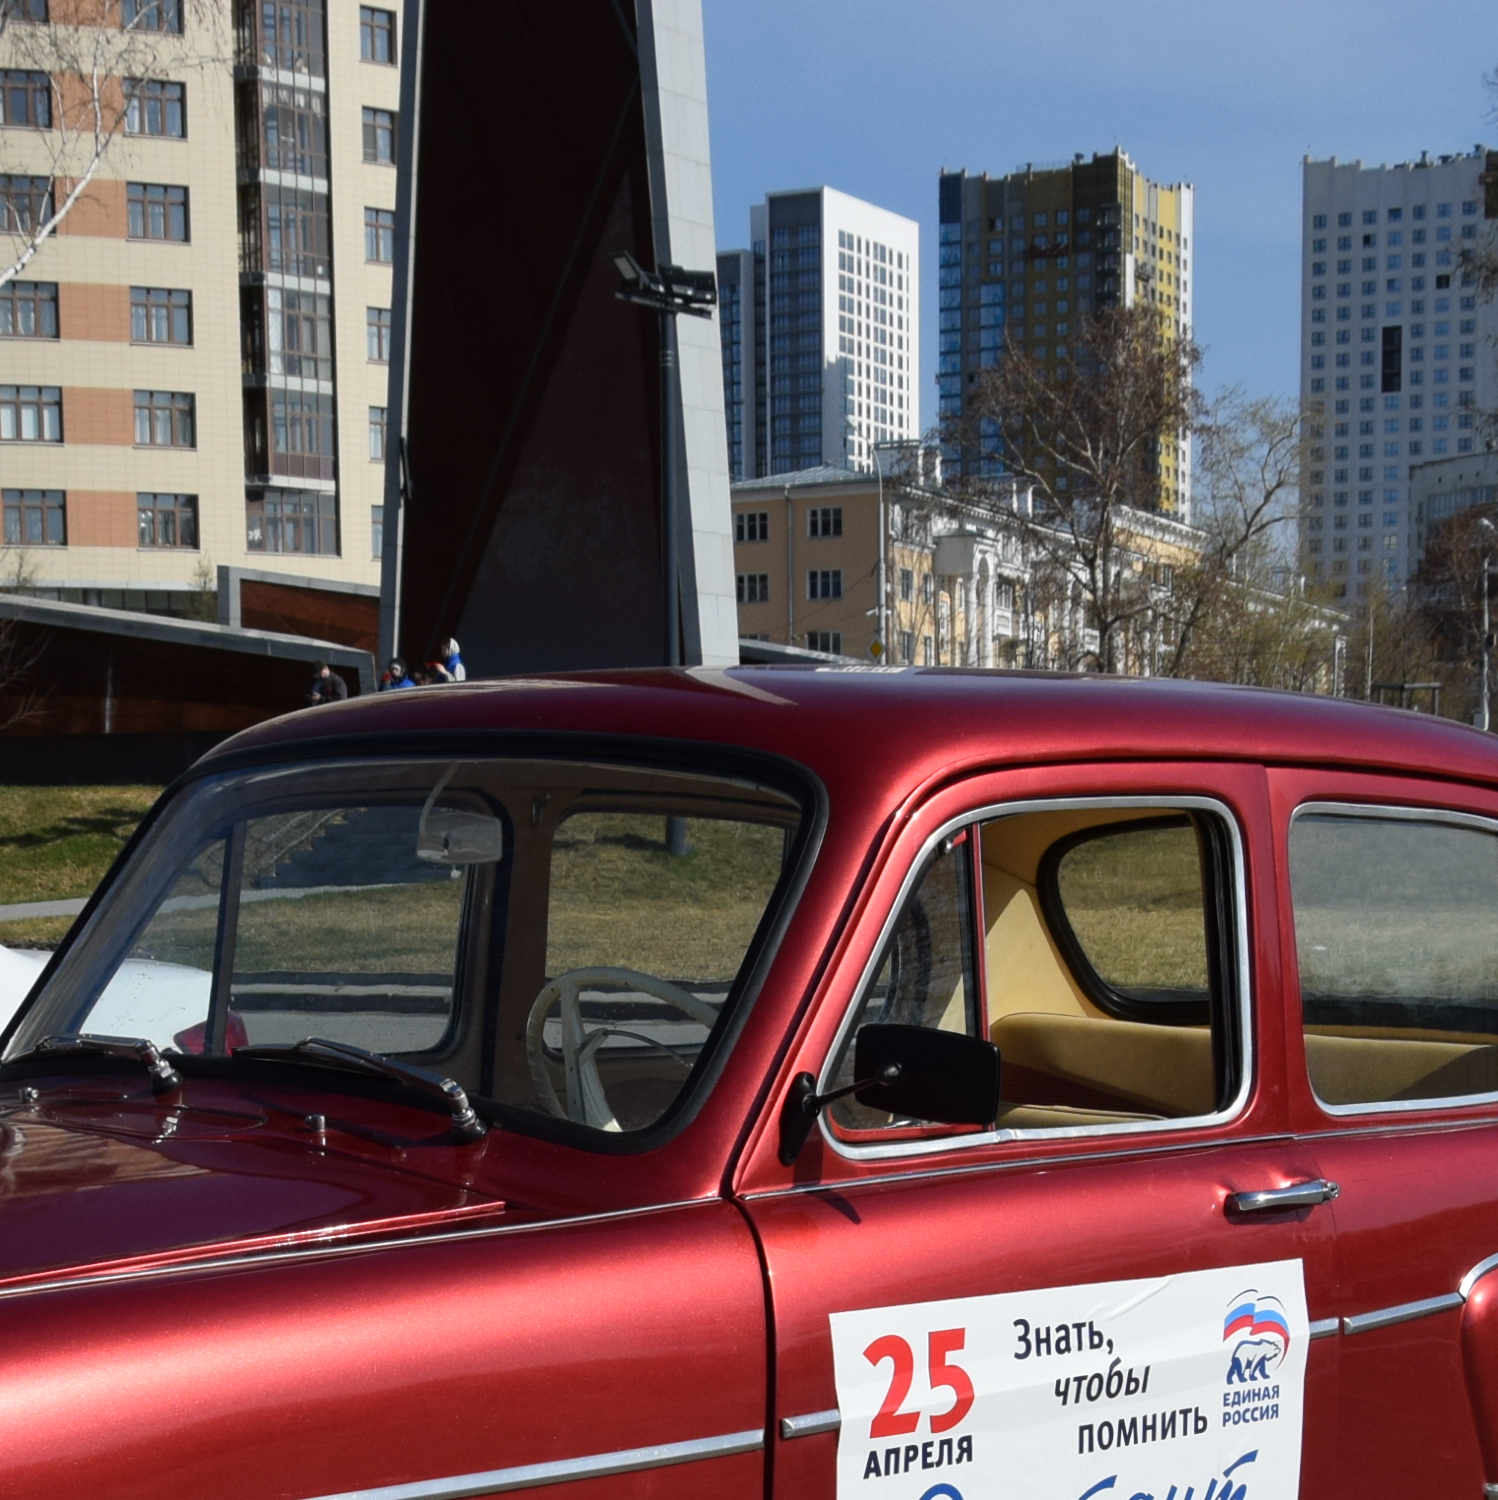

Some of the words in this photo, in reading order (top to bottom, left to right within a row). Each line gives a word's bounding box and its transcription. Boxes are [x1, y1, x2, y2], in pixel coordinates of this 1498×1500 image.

[1014, 1319, 1113, 1359] Знать,
[864, 1328, 974, 1438] 25
[1055, 1358, 1149, 1405] чтобы
[1224, 1385, 1279, 1407] ЕДИНАЯ
[1079, 1407, 1207, 1454] помнить
[1223, 1404, 1278, 1427] РОССИЯ
[864, 1435, 972, 1479] АПРЕЛЯ
